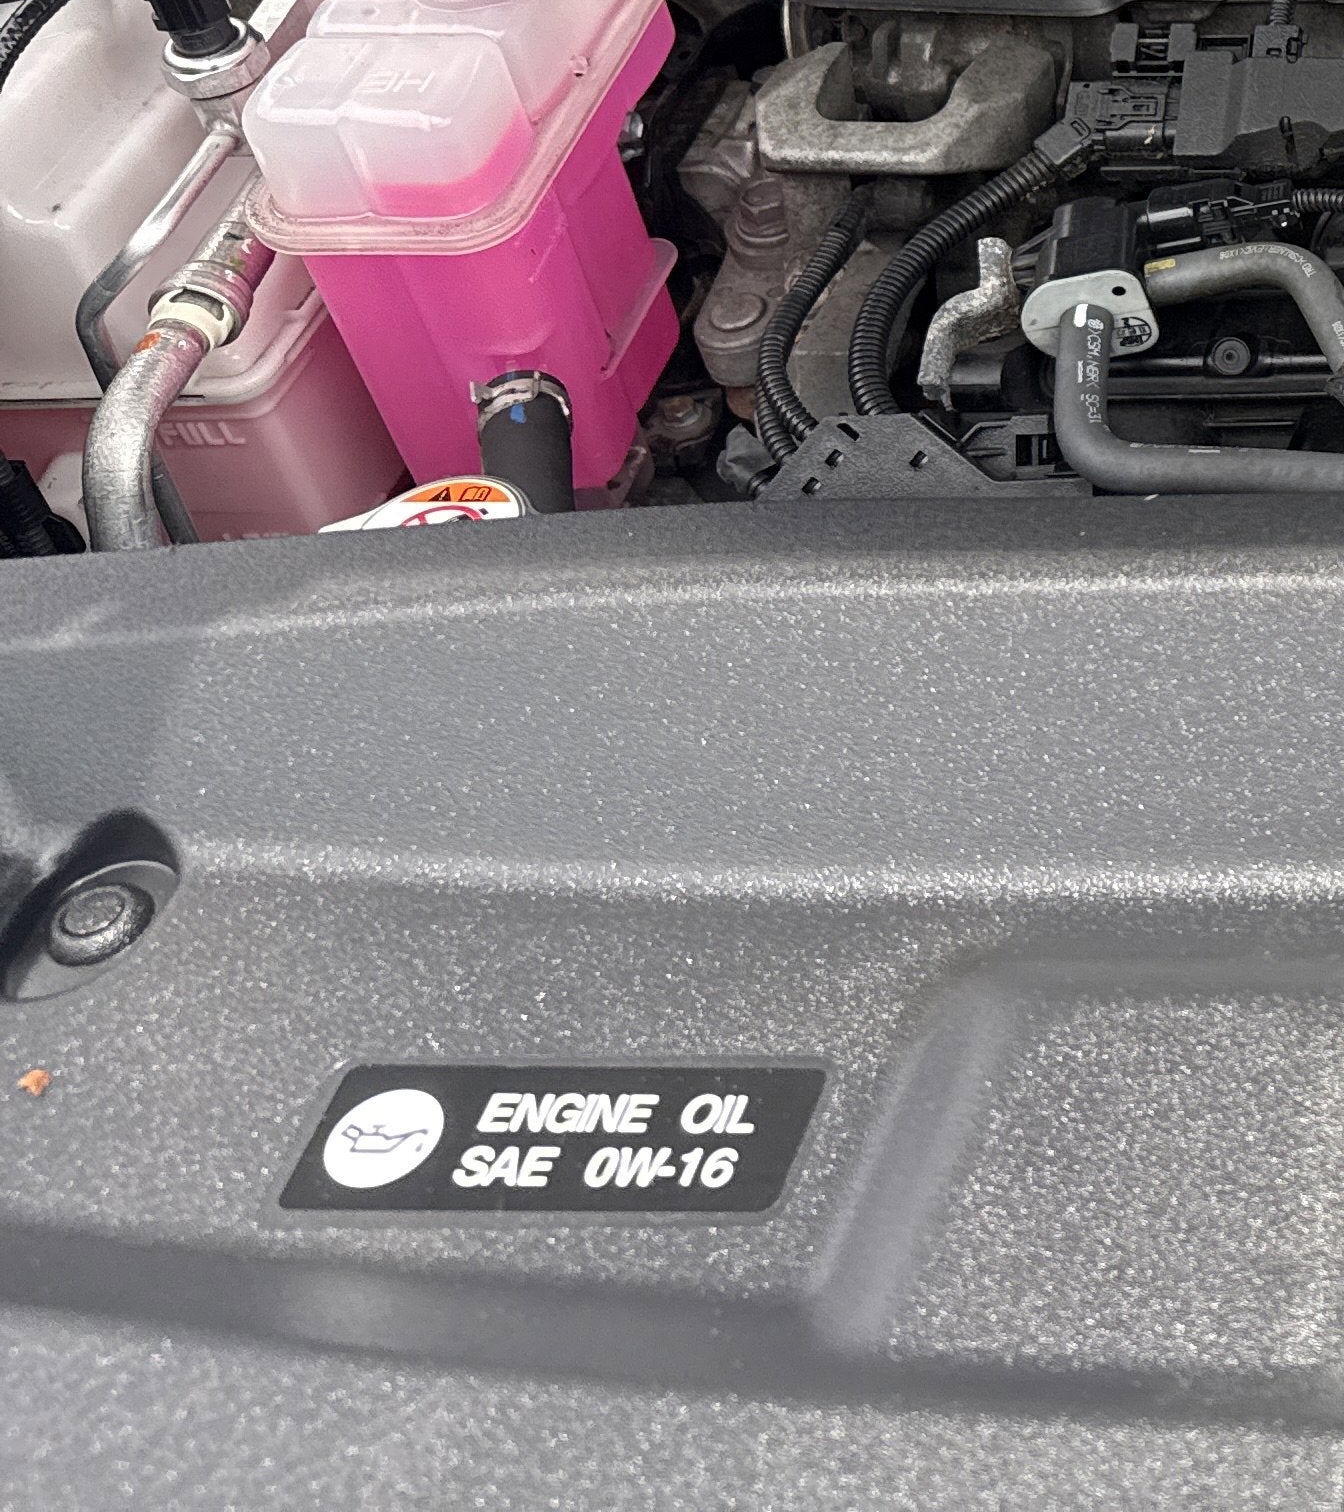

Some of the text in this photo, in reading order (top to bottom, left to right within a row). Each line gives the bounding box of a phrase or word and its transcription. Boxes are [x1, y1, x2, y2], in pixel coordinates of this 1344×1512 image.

[158, 421, 247, 446] FULL
[476, 1092, 756, 1135] ENGINE OIL
[451, 1145, 739, 1190] SAE 0W-16
